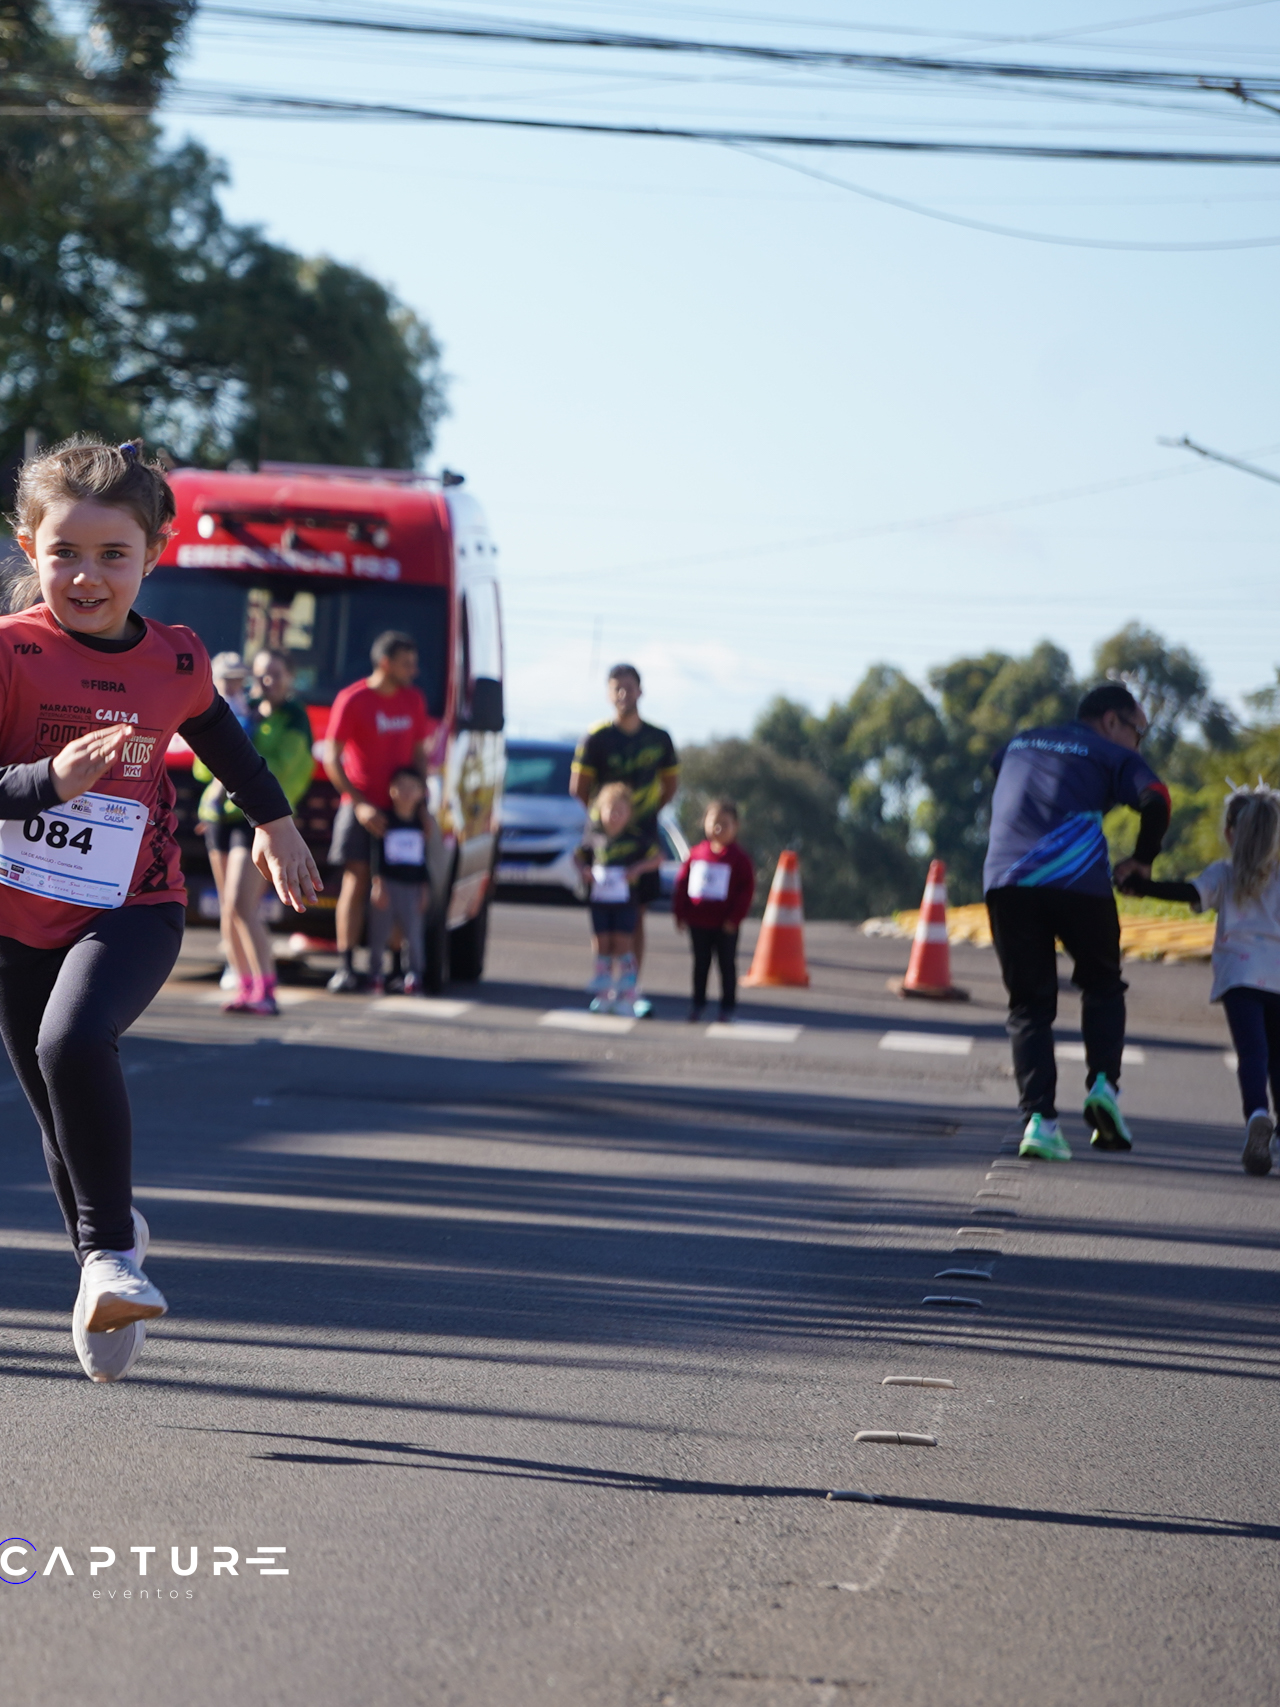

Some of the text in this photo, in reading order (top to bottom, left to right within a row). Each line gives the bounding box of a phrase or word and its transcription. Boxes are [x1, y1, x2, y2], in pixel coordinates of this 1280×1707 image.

[90, 679, 127, 693] FIBRA
[39, 703, 92, 715] MARATONA
[95, 708, 139, 724] CAIXA
[121, 742, 154, 764] KIDS
[22, 814, 94, 855] 084
